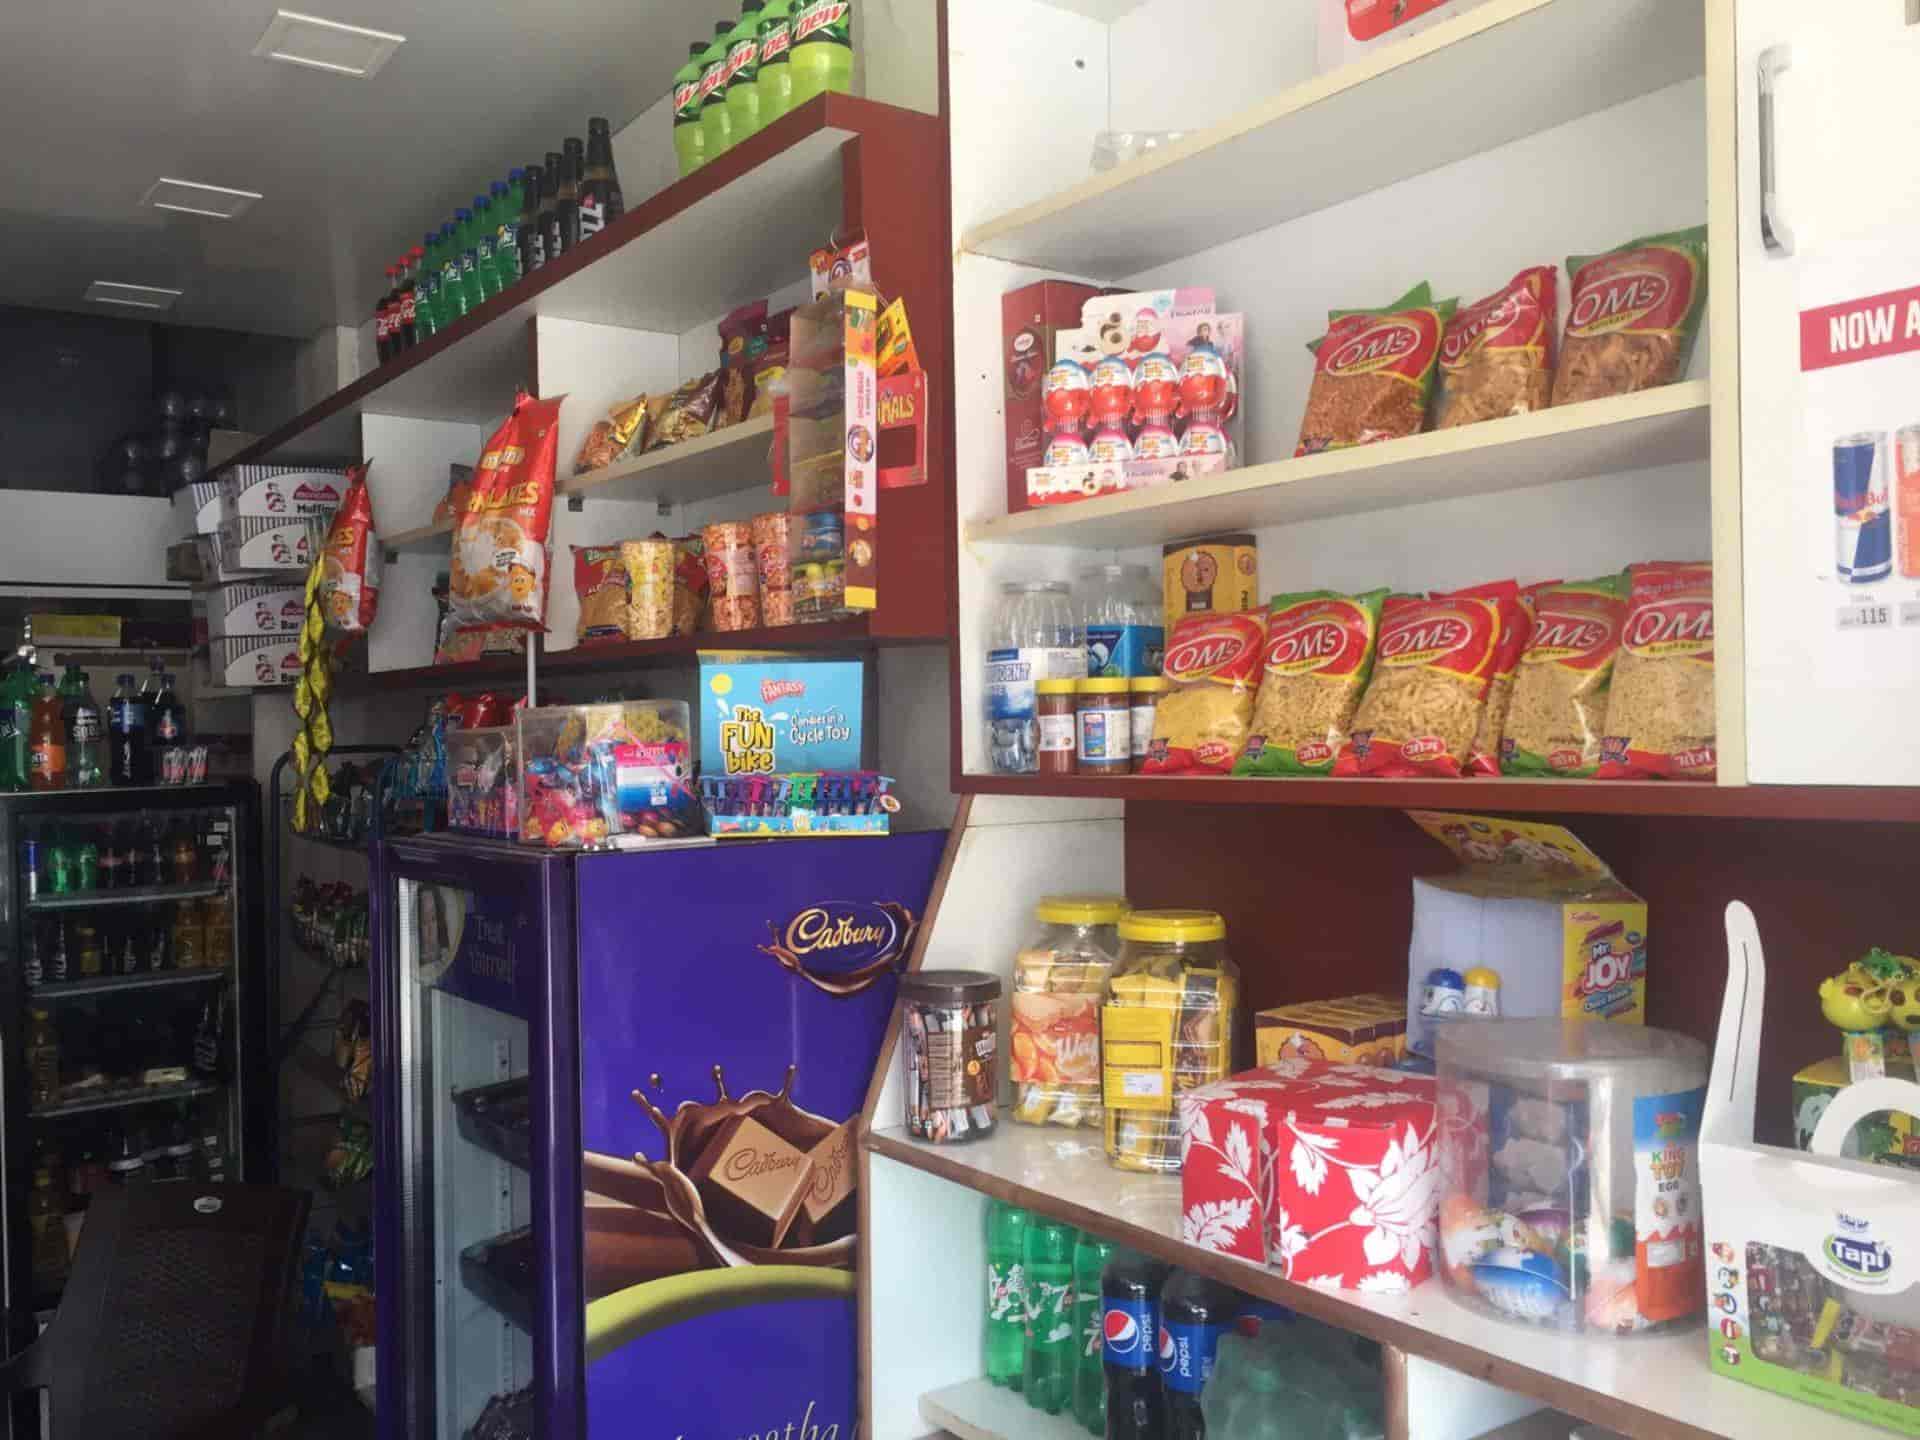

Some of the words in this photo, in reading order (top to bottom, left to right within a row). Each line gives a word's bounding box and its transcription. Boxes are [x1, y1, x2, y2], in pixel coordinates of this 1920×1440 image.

[1829, 303, 1897, 354] NOW
[734, 706, 763, 723] The
[721, 722, 774, 751] FUN
[727, 750, 775, 775] bike
[785, 907, 886, 955] Cadbury
[1584, 954, 1632, 992] JOY
[723, 1147, 801, 1182] Cadbury
[1832, 1240, 1885, 1273] Tapi
[1177, 1336, 1193, 1378] pepsi
